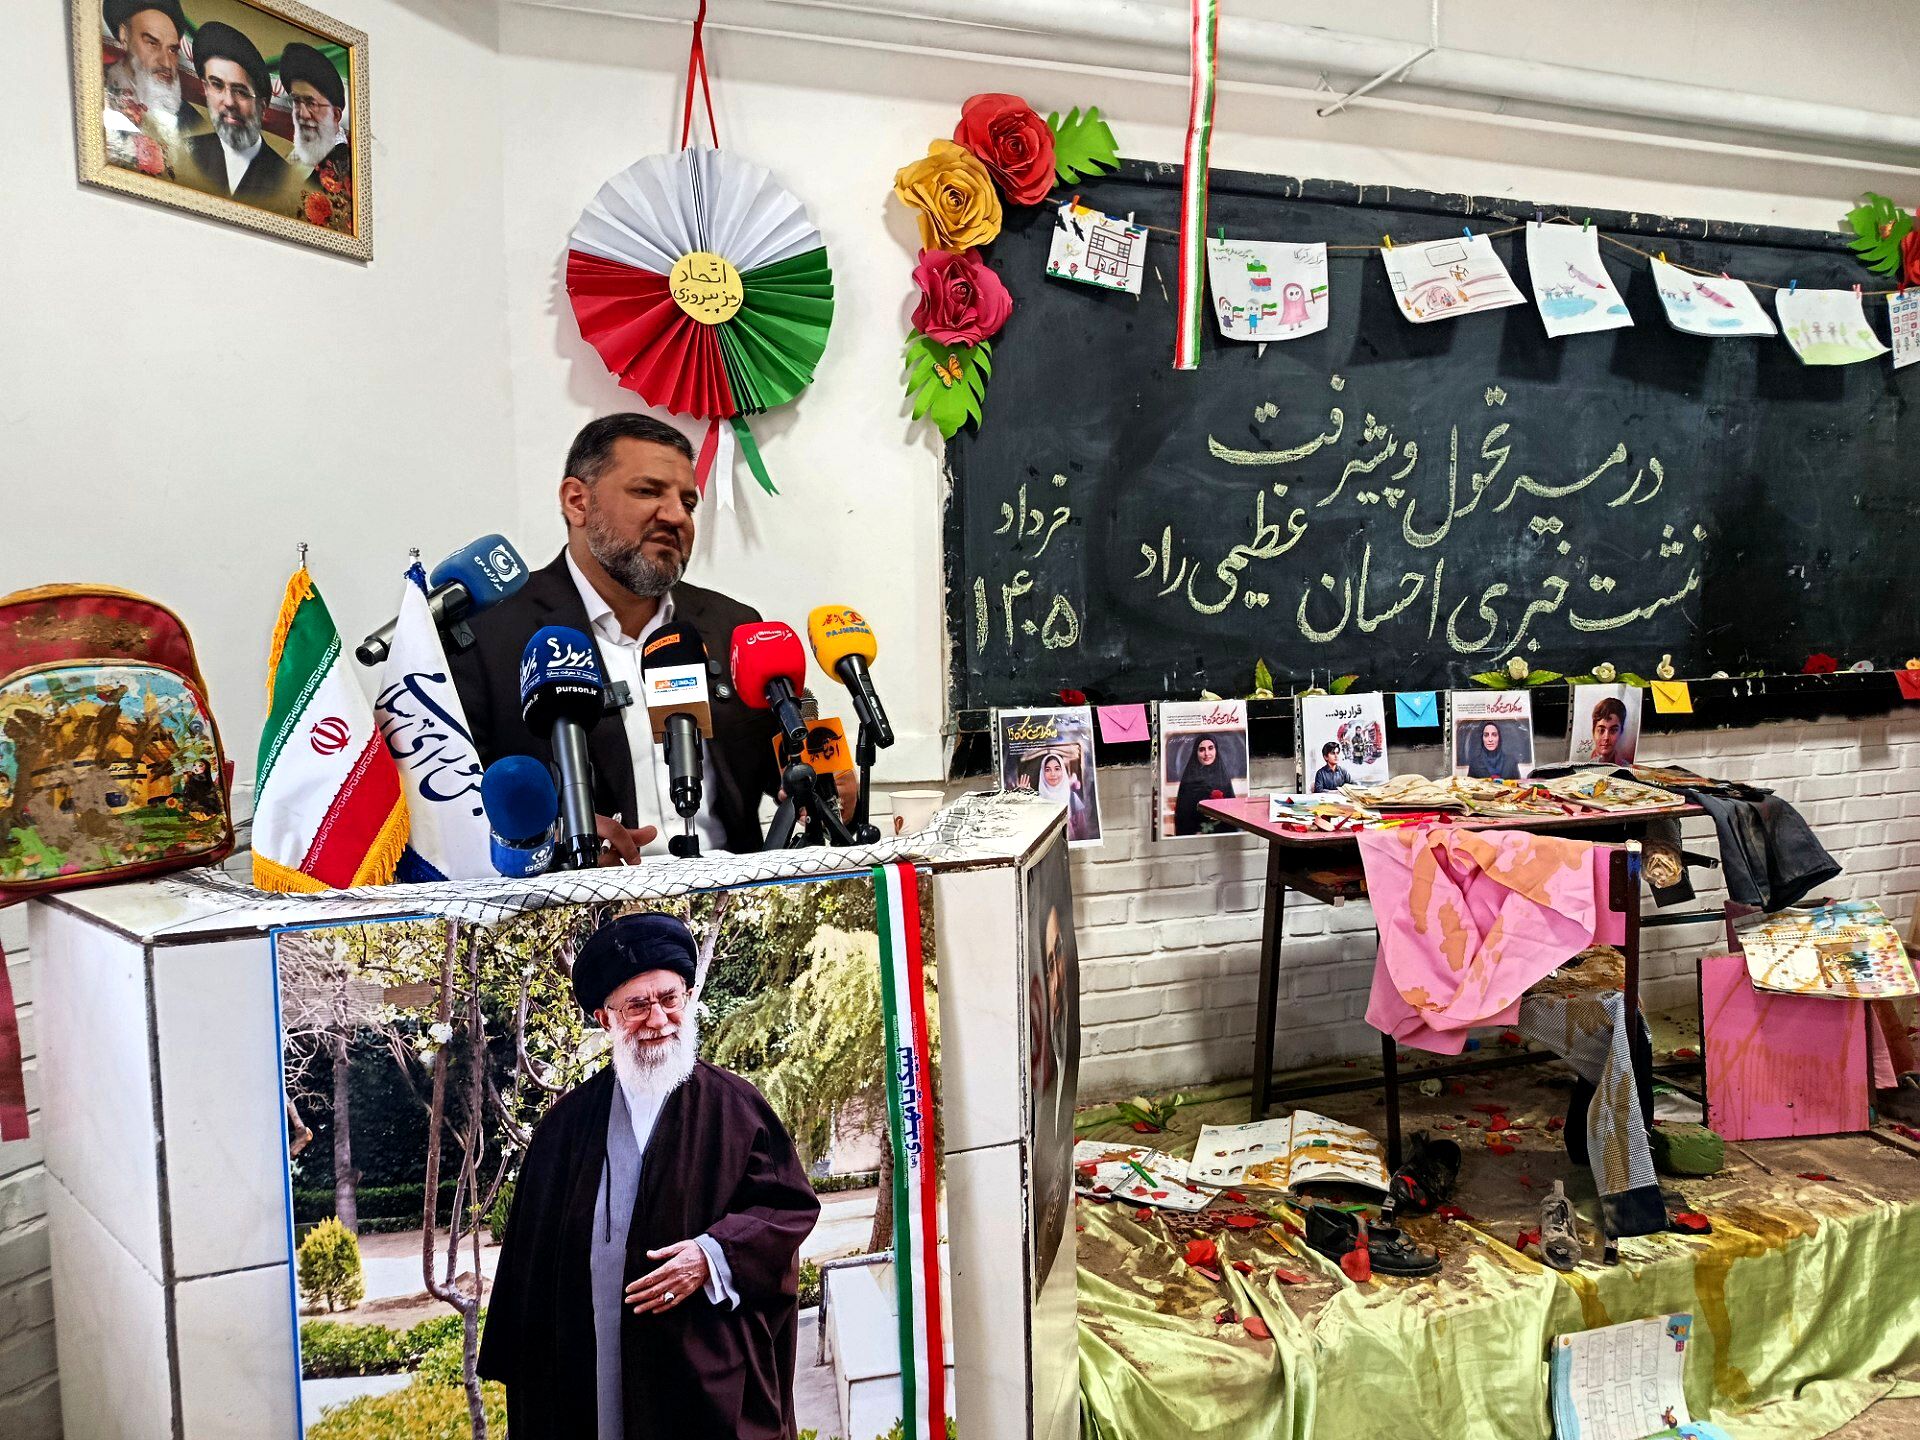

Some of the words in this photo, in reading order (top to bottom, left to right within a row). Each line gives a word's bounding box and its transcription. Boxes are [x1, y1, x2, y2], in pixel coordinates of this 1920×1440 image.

[673, 288, 719, 314] پیروزی
[721, 290, 741, 308] رمز
[1207, 373, 1406, 509] پیشرفت
[1391, 440, 1419, 481] و
[1402, 384, 1512, 549] تحول
[993, 472, 1072, 559] خرداد
[1492, 442, 1628, 535] مسیر
[1606, 456, 1665, 508] در
[1133, 525, 1188, 597] راد
[1187, 482, 1309, 616] عظیمی
[1569, 523, 1708, 632] نشست
[972, 569, 1080, 656] ۱۴۰۵
[1296, 542, 1445, 643] احسان
[1446, 539, 1572, 663] خبری
[555, 686, 598, 696] purson.ir
[1325, 709, 1347, 720] بود...
[1347, 704, 1362, 719] قرار
[896, 1046, 920, 1089] لبیک
[903, 1105, 924, 1156] مهدی
